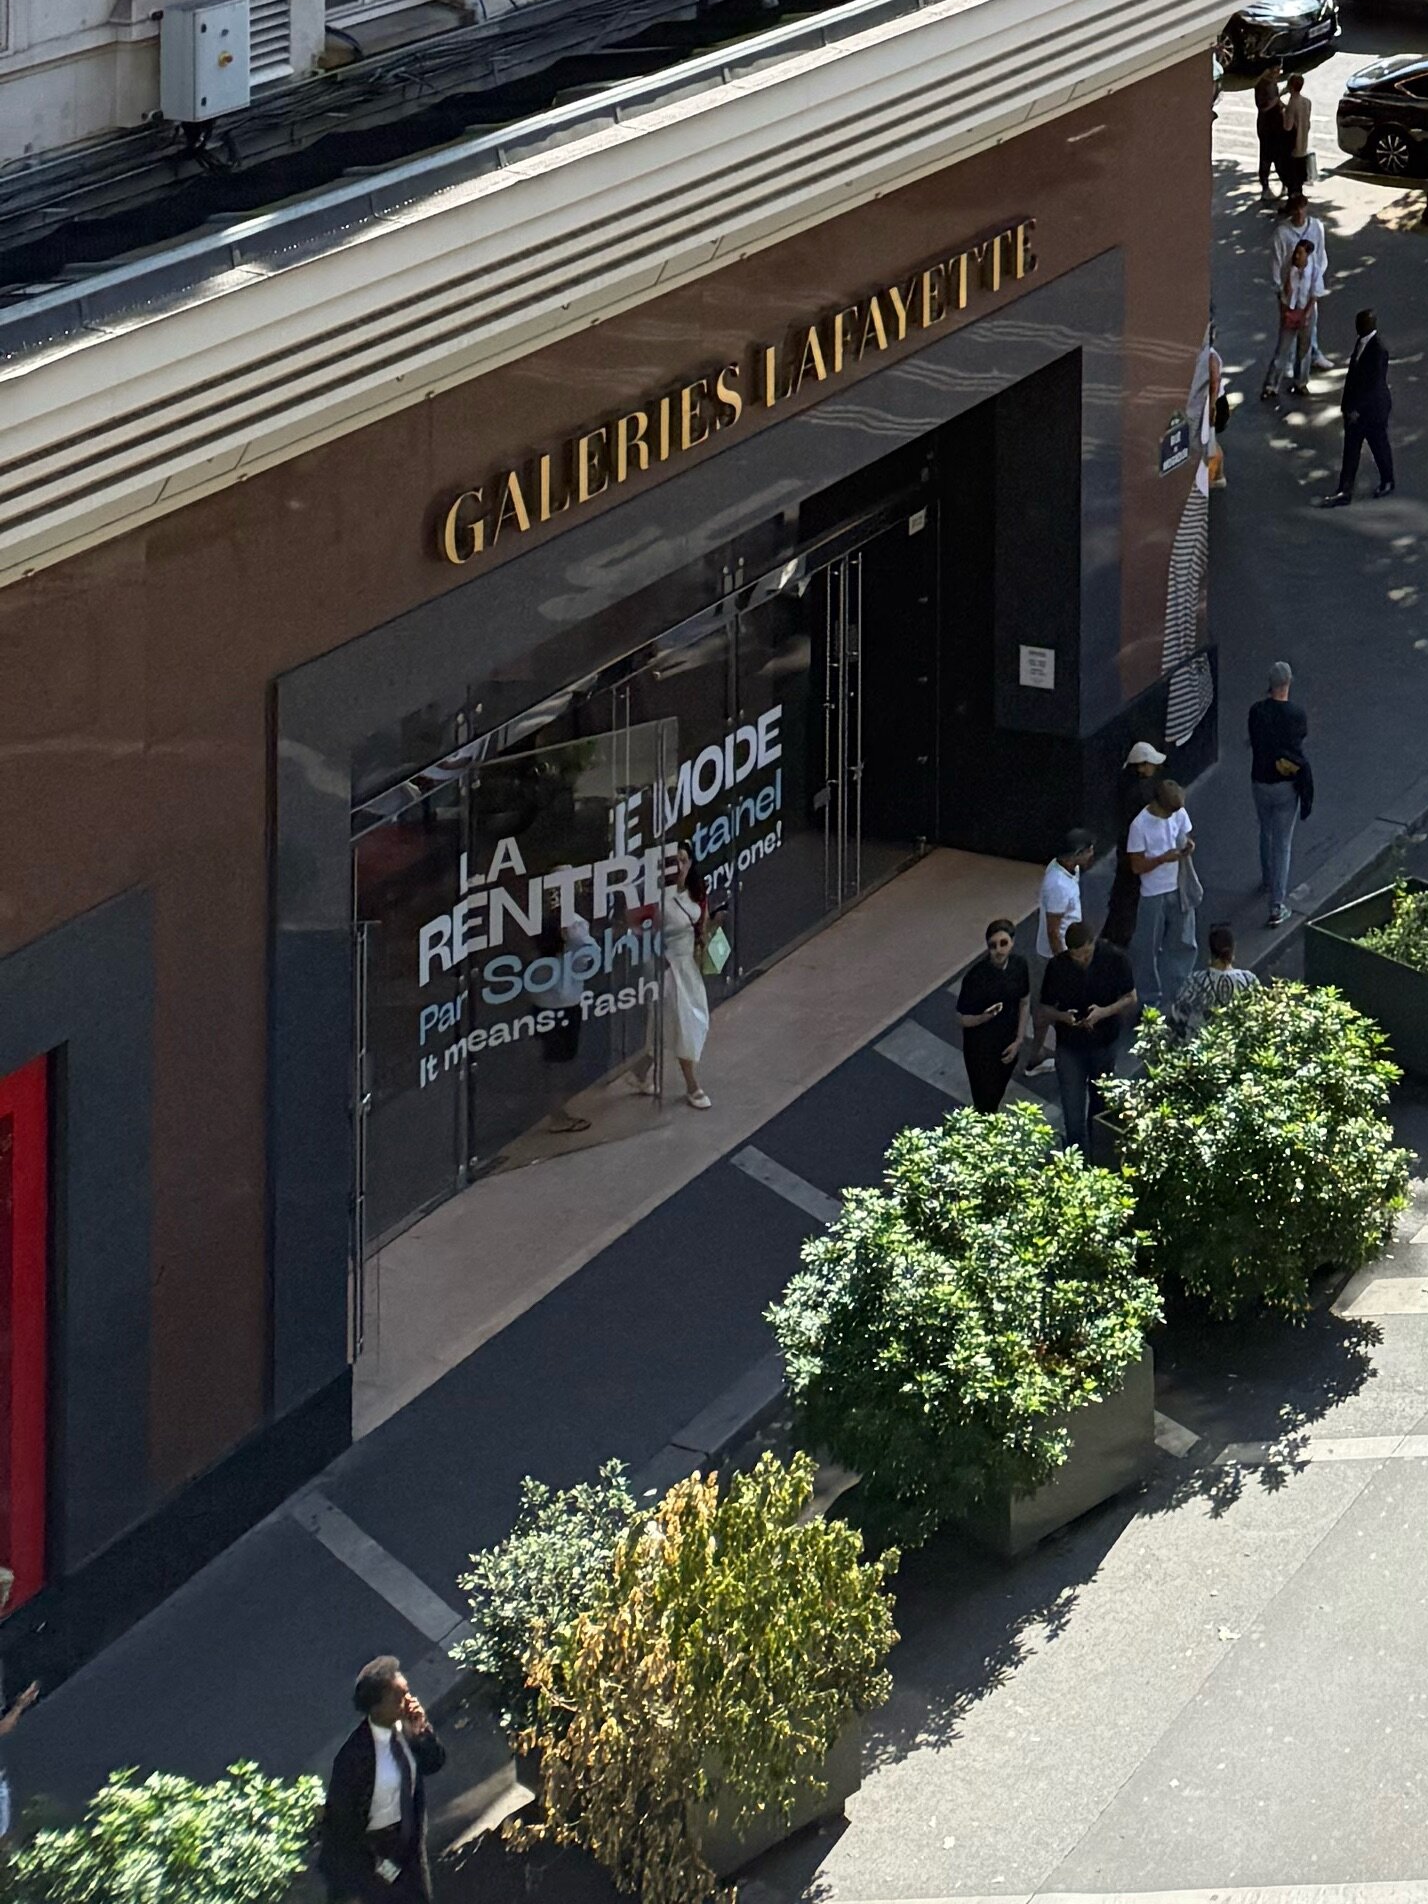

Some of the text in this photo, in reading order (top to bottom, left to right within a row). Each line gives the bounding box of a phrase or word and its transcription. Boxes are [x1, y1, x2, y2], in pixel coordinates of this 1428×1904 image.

[444, 217, 1038, 565] GALERIES LAFAYETTE
[419, 841, 678, 988] RENTRE
[420, 989, 469, 1046] Par
[689, 767, 782, 863] tanel
[420, 1055, 439, 1089] It
[444, 1009, 570, 1071] means:
[579, 977, 660, 1021] fash
[737, 820, 783, 872] one!
[459, 836, 527, 896] LA
